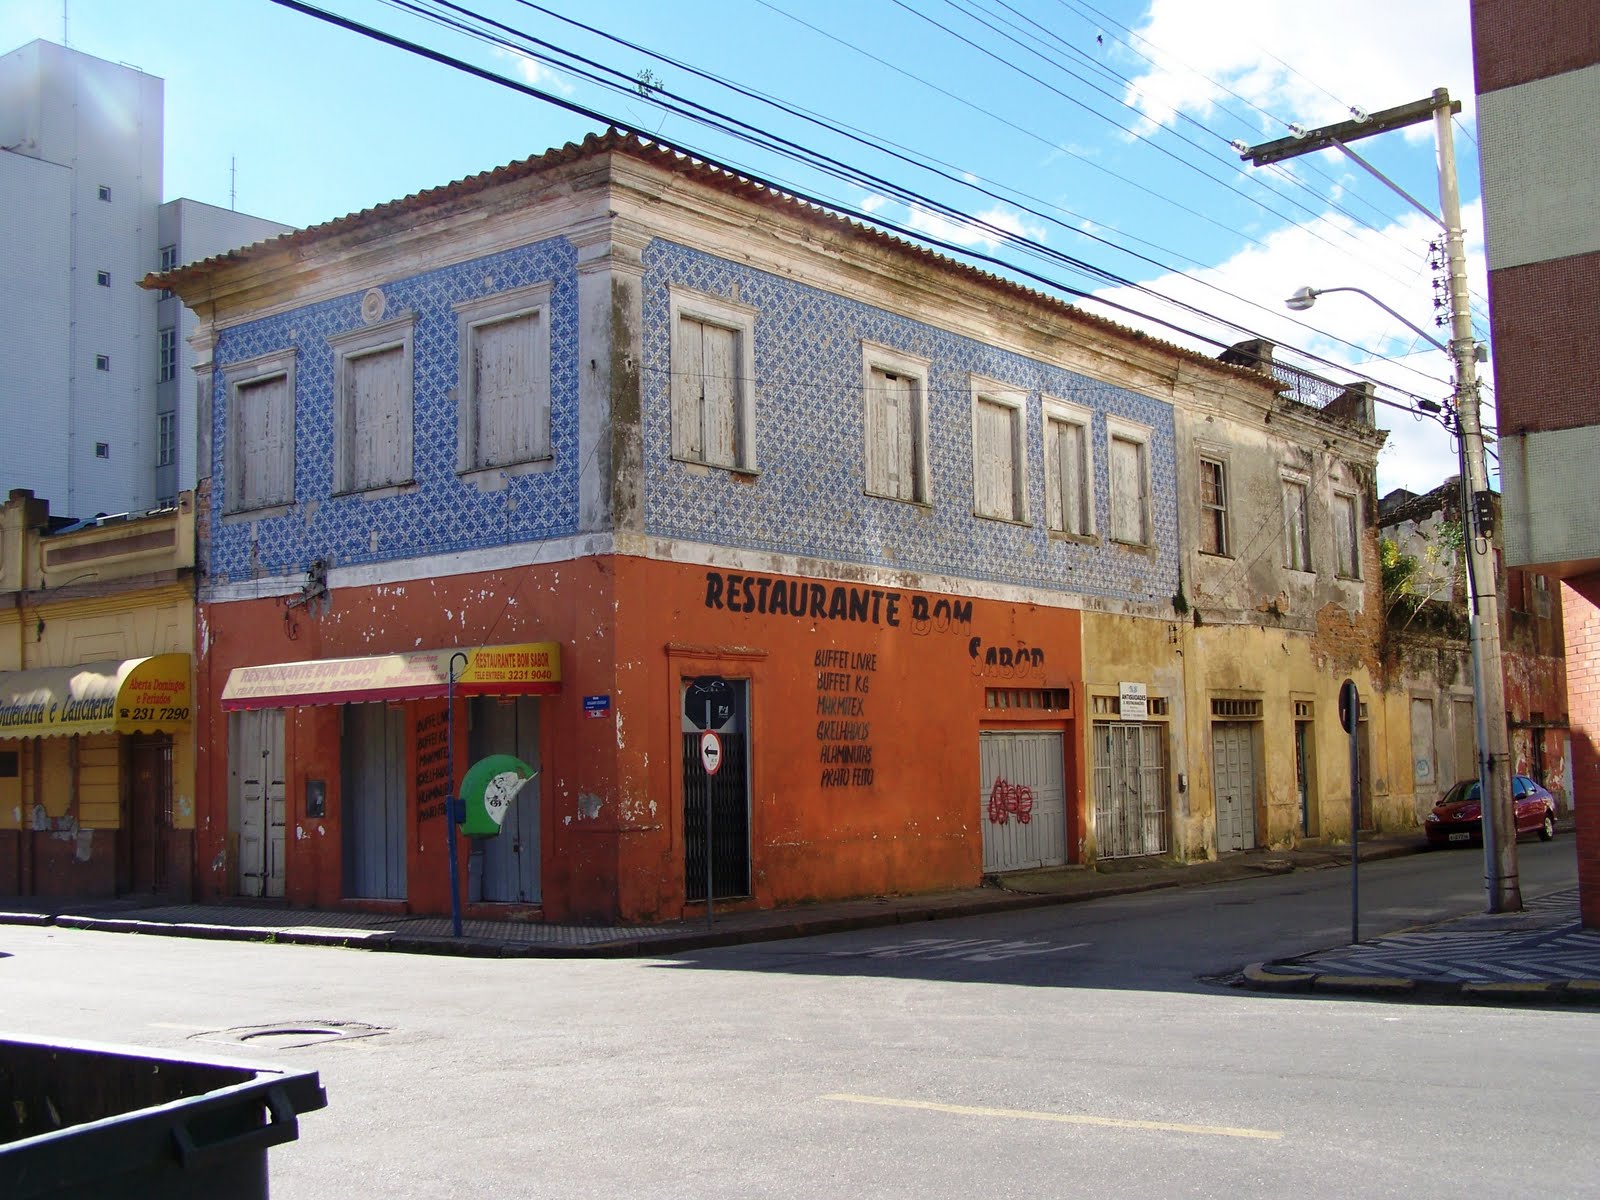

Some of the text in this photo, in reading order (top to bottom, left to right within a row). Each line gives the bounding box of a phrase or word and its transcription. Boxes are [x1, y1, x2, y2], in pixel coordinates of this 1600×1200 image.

[705, 572, 973, 636] RESTAURANTE BOM
[475, 653, 549, 668] RESTAURANTE BOM SABOR
[814, 649, 877, 671] BUFFET LIVRE
[241, 660, 378, 682] RESTAURANTE BOM SABOR
[508, 670, 528, 679] 3231
[531, 670, 551, 679] 9040
[153, 679, 186, 693] Domingos
[817, 672, 869, 693] BUFFET KG
[49, 701, 57, 722] e
[61, 694, 115, 722] Lancheria
[136, 693, 171, 704] e Feriados
[817, 696, 864, 717] MARMITEX
[131, 707, 189, 720] 231 7290
[817, 720, 870, 740] GRELHADOS
[820, 745, 873, 763] ALAMINUTAS
[821, 768, 874, 787] PRATO FEITO
